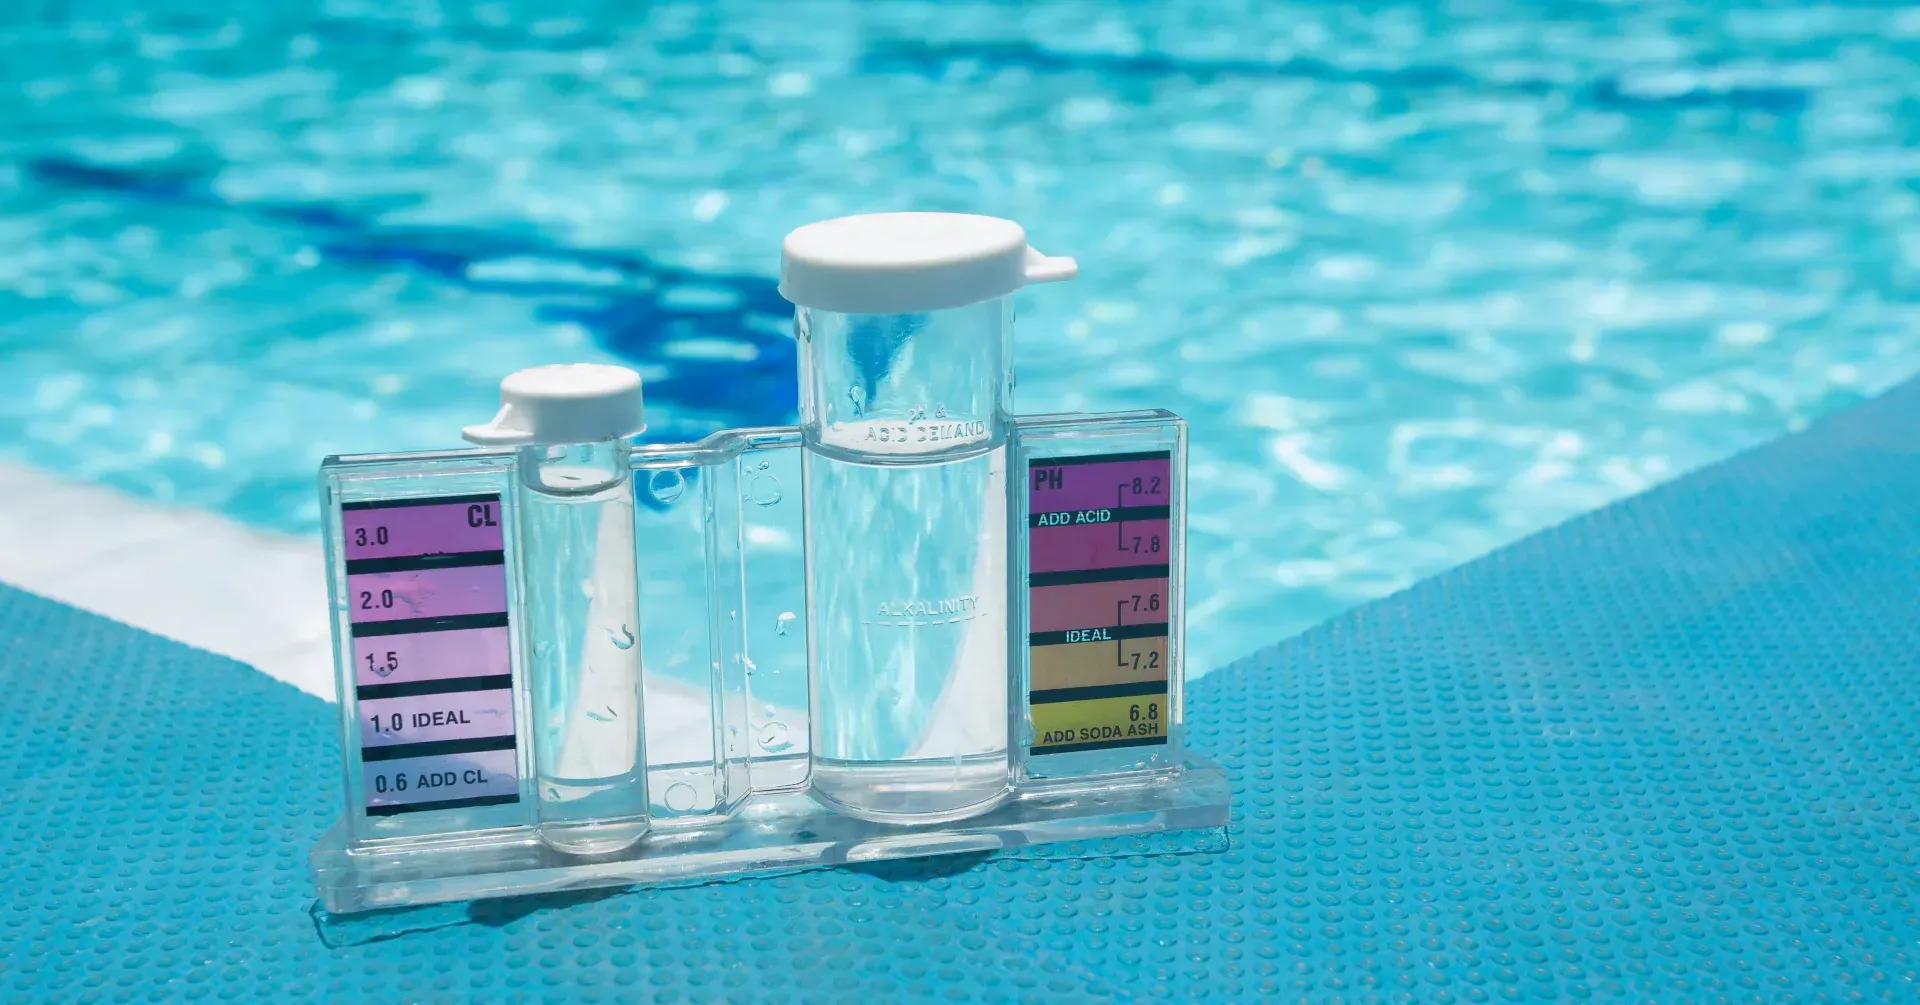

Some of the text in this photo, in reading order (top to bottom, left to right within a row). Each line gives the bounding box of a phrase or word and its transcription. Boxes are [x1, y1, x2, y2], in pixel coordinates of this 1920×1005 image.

[917, 421, 985, 442] DEMAND
[1034, 469, 1063, 490] PH
[1132, 476, 1161, 494] 8.2
[467, 504, 497, 527] CL
[1038, 509, 1111, 526] ADD ACID
[355, 526, 389, 547] 3.0
[1132, 535, 1160, 554] 7.8
[360, 589, 394, 610] 2.0
[878, 596, 979, 616] ALKALINITY
[1131, 593, 1160, 612] 7.6
[1066, 628, 1112, 643] IDEAL
[365, 651, 398, 673] 1.5
[1131, 651, 1159, 670] 7.2
[370, 709, 471, 733] 1.0 IDEAL
[1129, 703, 1158, 722] 6.8
[1042, 722, 1158, 744] ADD SODA ASH
[374, 768, 488, 794] 0.6 ADD CL
